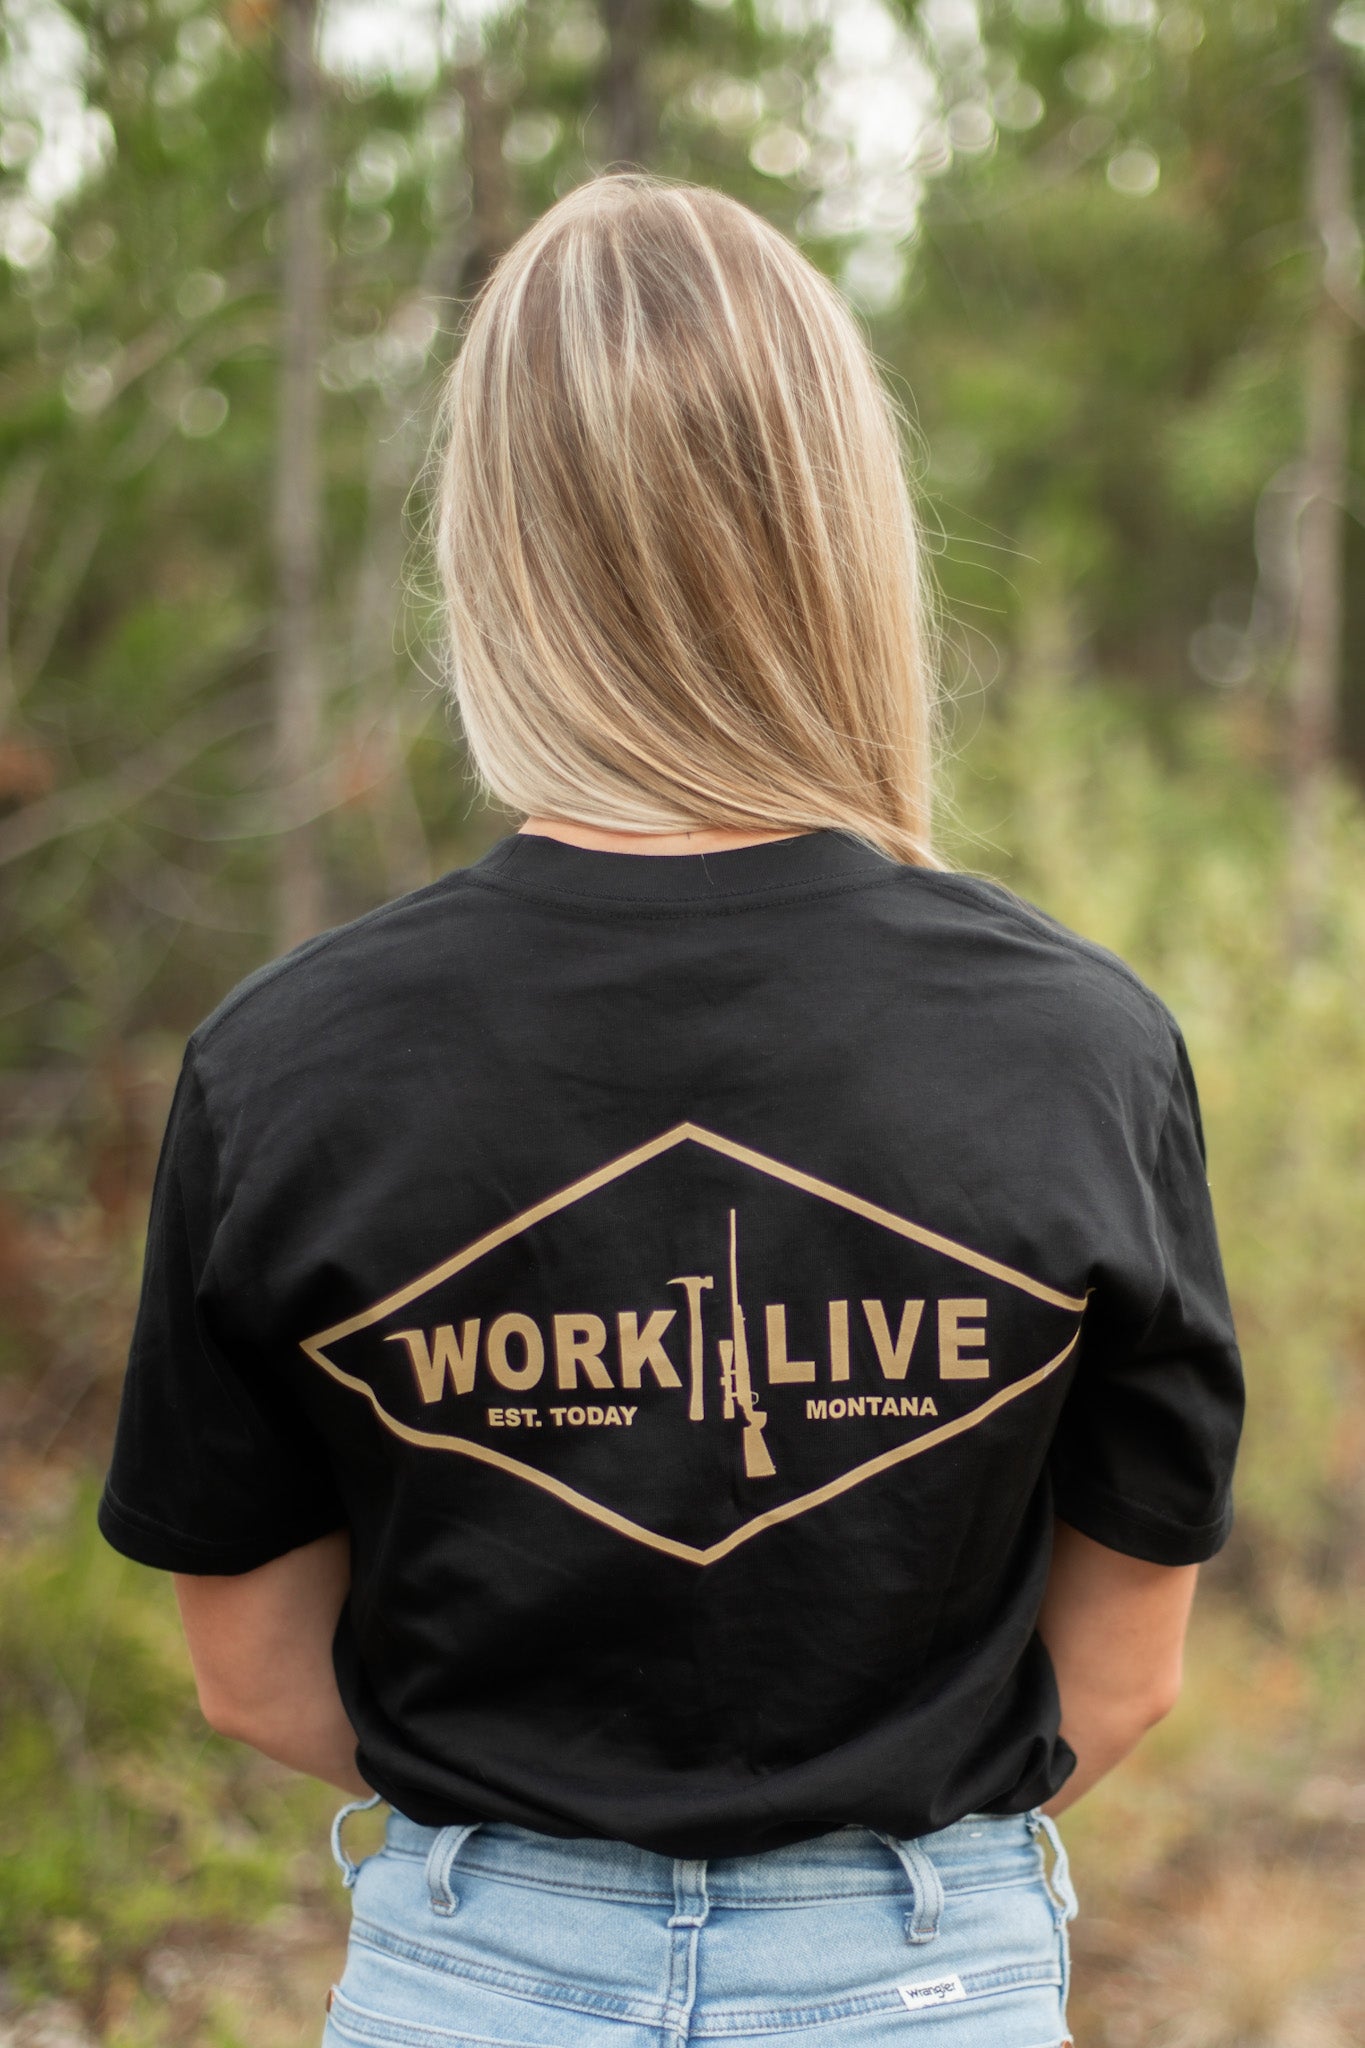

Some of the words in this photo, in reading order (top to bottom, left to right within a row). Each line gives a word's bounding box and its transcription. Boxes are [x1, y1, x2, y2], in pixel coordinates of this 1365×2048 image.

[384, 1309, 683, 1404] WORK
[765, 1298, 991, 1385] LIVE
[487, 1407, 543, 1428] EST.
[549, 1405, 638, 1427] TODAY
[805, 1396, 939, 1420] MONTANA
[905, 1982, 956, 1999] Wrangler
